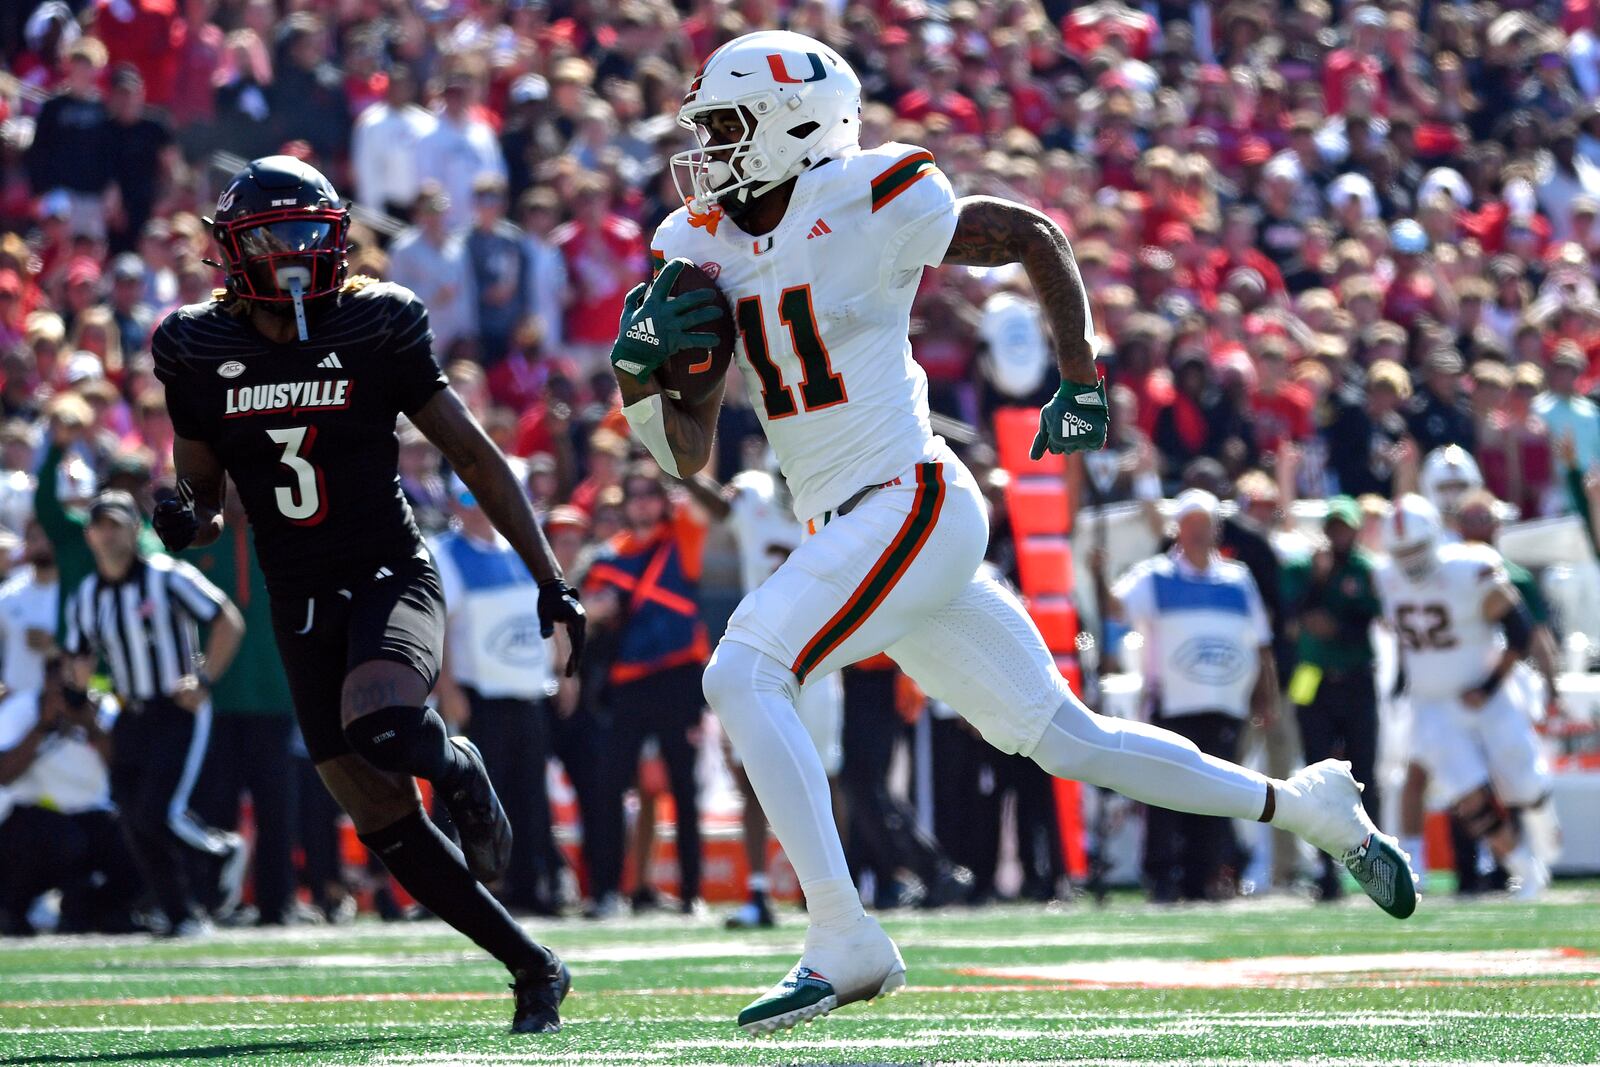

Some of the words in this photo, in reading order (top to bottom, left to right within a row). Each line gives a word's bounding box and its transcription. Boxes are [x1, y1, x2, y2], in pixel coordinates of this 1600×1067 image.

[766, 52, 827, 83] U
[753, 236, 774, 255] U
[626, 330, 660, 346] adidas
[736, 283, 848, 420] 11
[223, 364, 241, 373] ACC
[223, 379, 352, 416] LOUISVILLE
[265, 426, 325, 523] 3
[1396, 602, 1460, 652] 52
